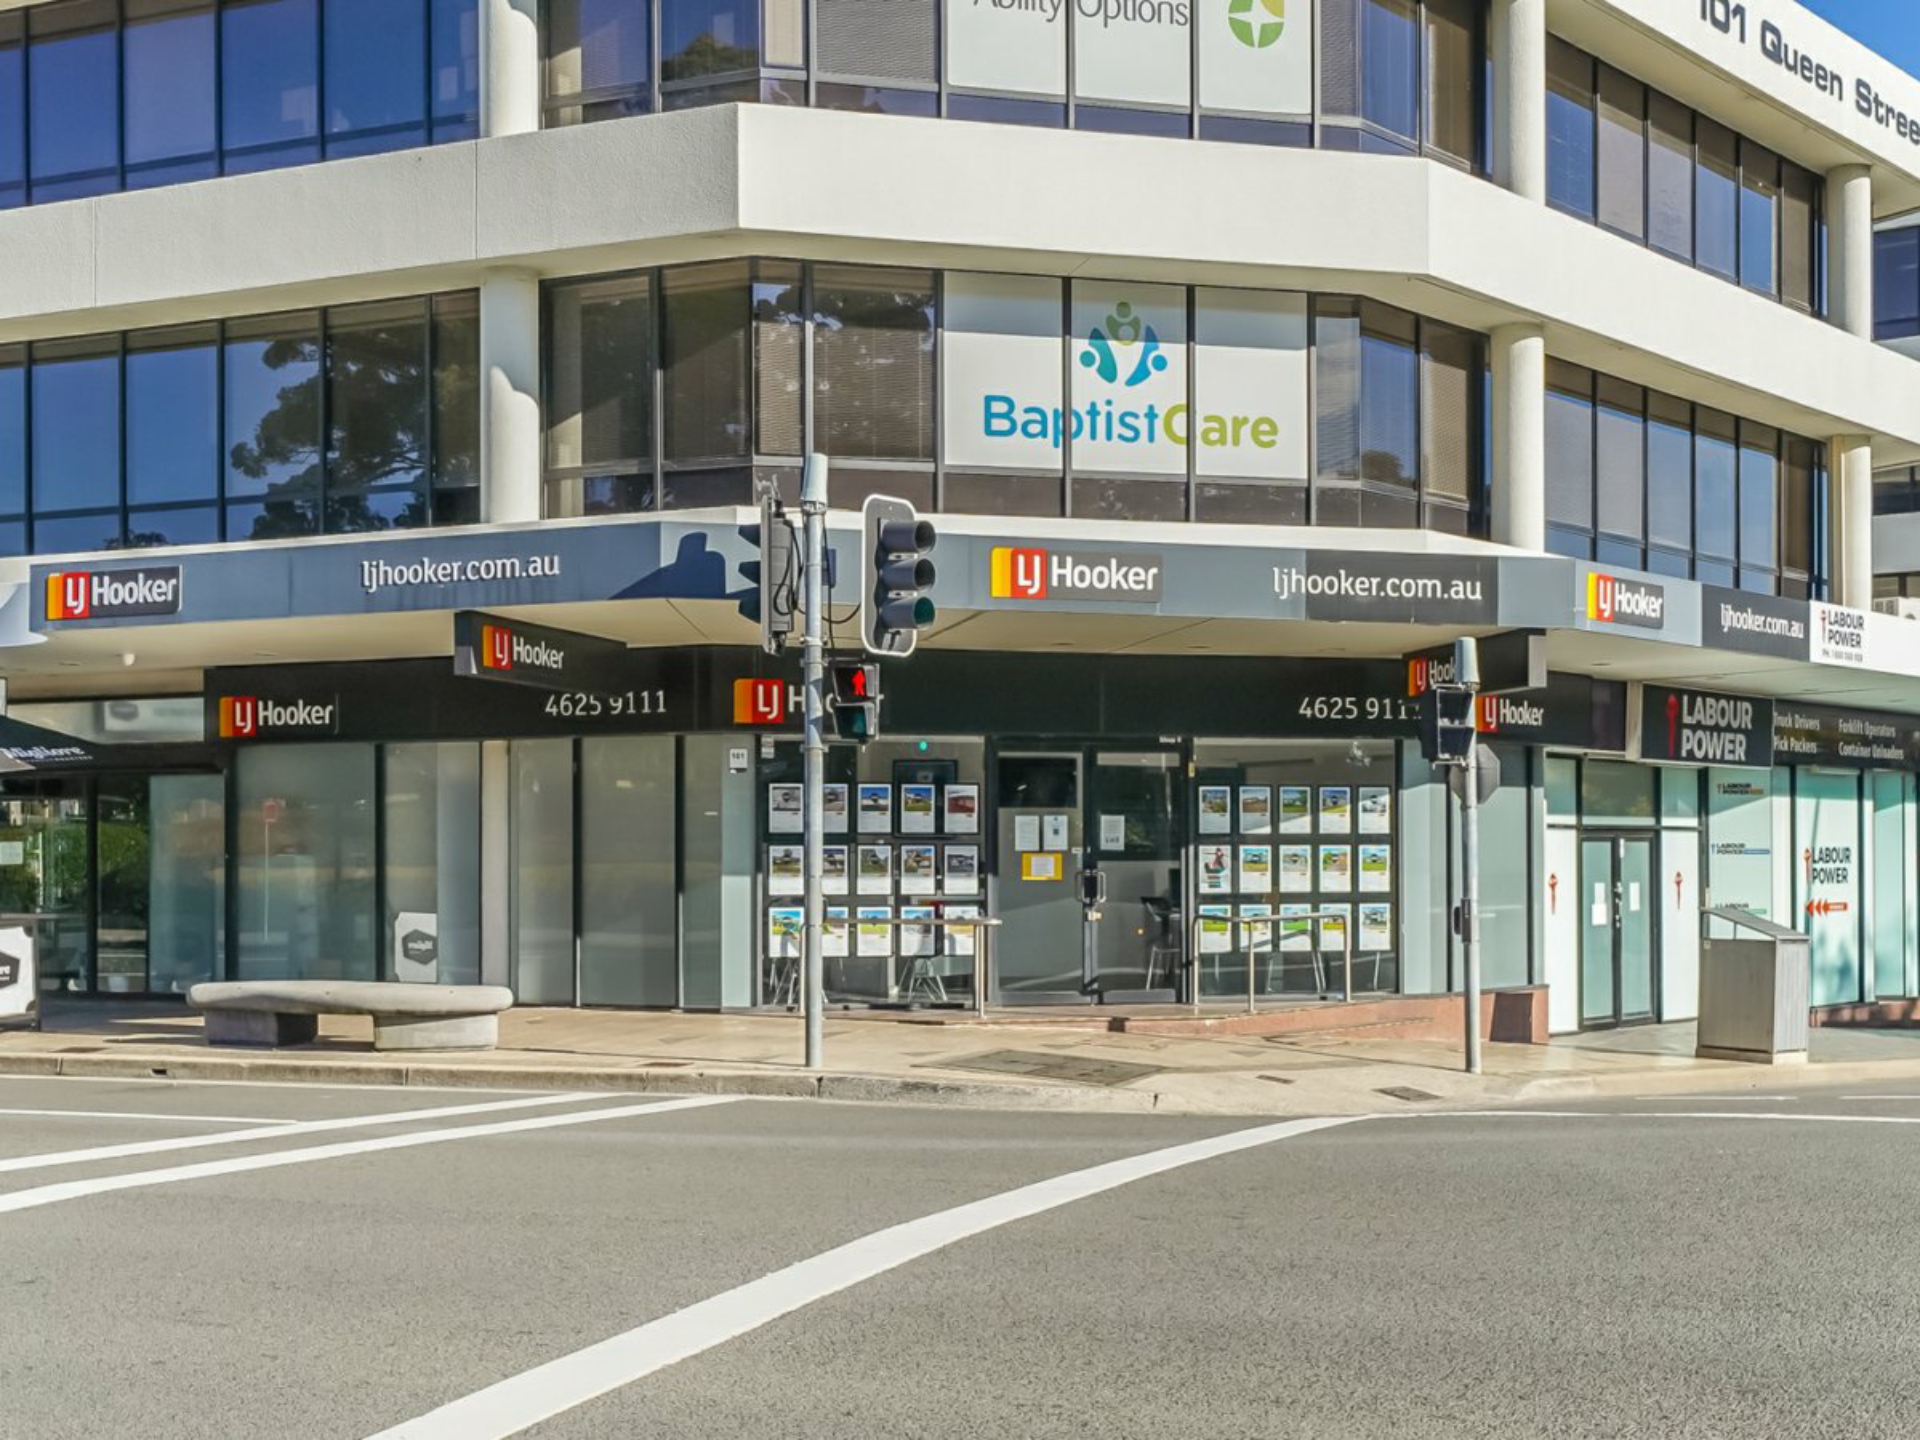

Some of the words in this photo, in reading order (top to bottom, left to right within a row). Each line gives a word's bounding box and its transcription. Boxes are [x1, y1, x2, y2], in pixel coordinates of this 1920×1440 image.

[1078, 0, 1189, 28] Options
[1761, 19, 1843, 101] Queen
[983, 394, 1280, 449] BaptistCare
[362, 555, 561, 593] ljhooker.com.au
[1017, 554, 1042, 595] LJ
[1051, 555, 1159, 591] Hooker
[1272, 566, 1483, 601] ljhooker.com.au
[66, 577, 86, 615] LJ
[92, 572, 177, 606] Hooker
[1598, 579, 1612, 618] LJ
[1614, 582, 1663, 619] Hooker
[1720, 603, 1805, 639] ljhooker.com.au
[1828, 609, 1865, 631] LABOUR
[494, 632, 509, 666] LJ
[512, 635, 565, 670] Hooker
[1828, 628, 1862, 649] POWER
[1428, 656, 1456, 683] Hook
[234, 702, 252, 734] LJ
[257, 699, 334, 727] Hooker
[544, 692, 602, 717] 4625
[609, 690, 667, 714] 9111
[757, 684, 779, 720] LJ
[1298, 697, 1358, 719] 4625
[1365, 697, 1422, 720] 911
[1485, 697, 1498, 729] LJ
[1499, 698, 1545, 726] Hooker
[1682, 694, 1753, 731] LABOUR
[1681, 728, 1747, 762] POWER
[1812, 846, 1852, 865] LABOUR
[1812, 866, 1849, 884] POWER
